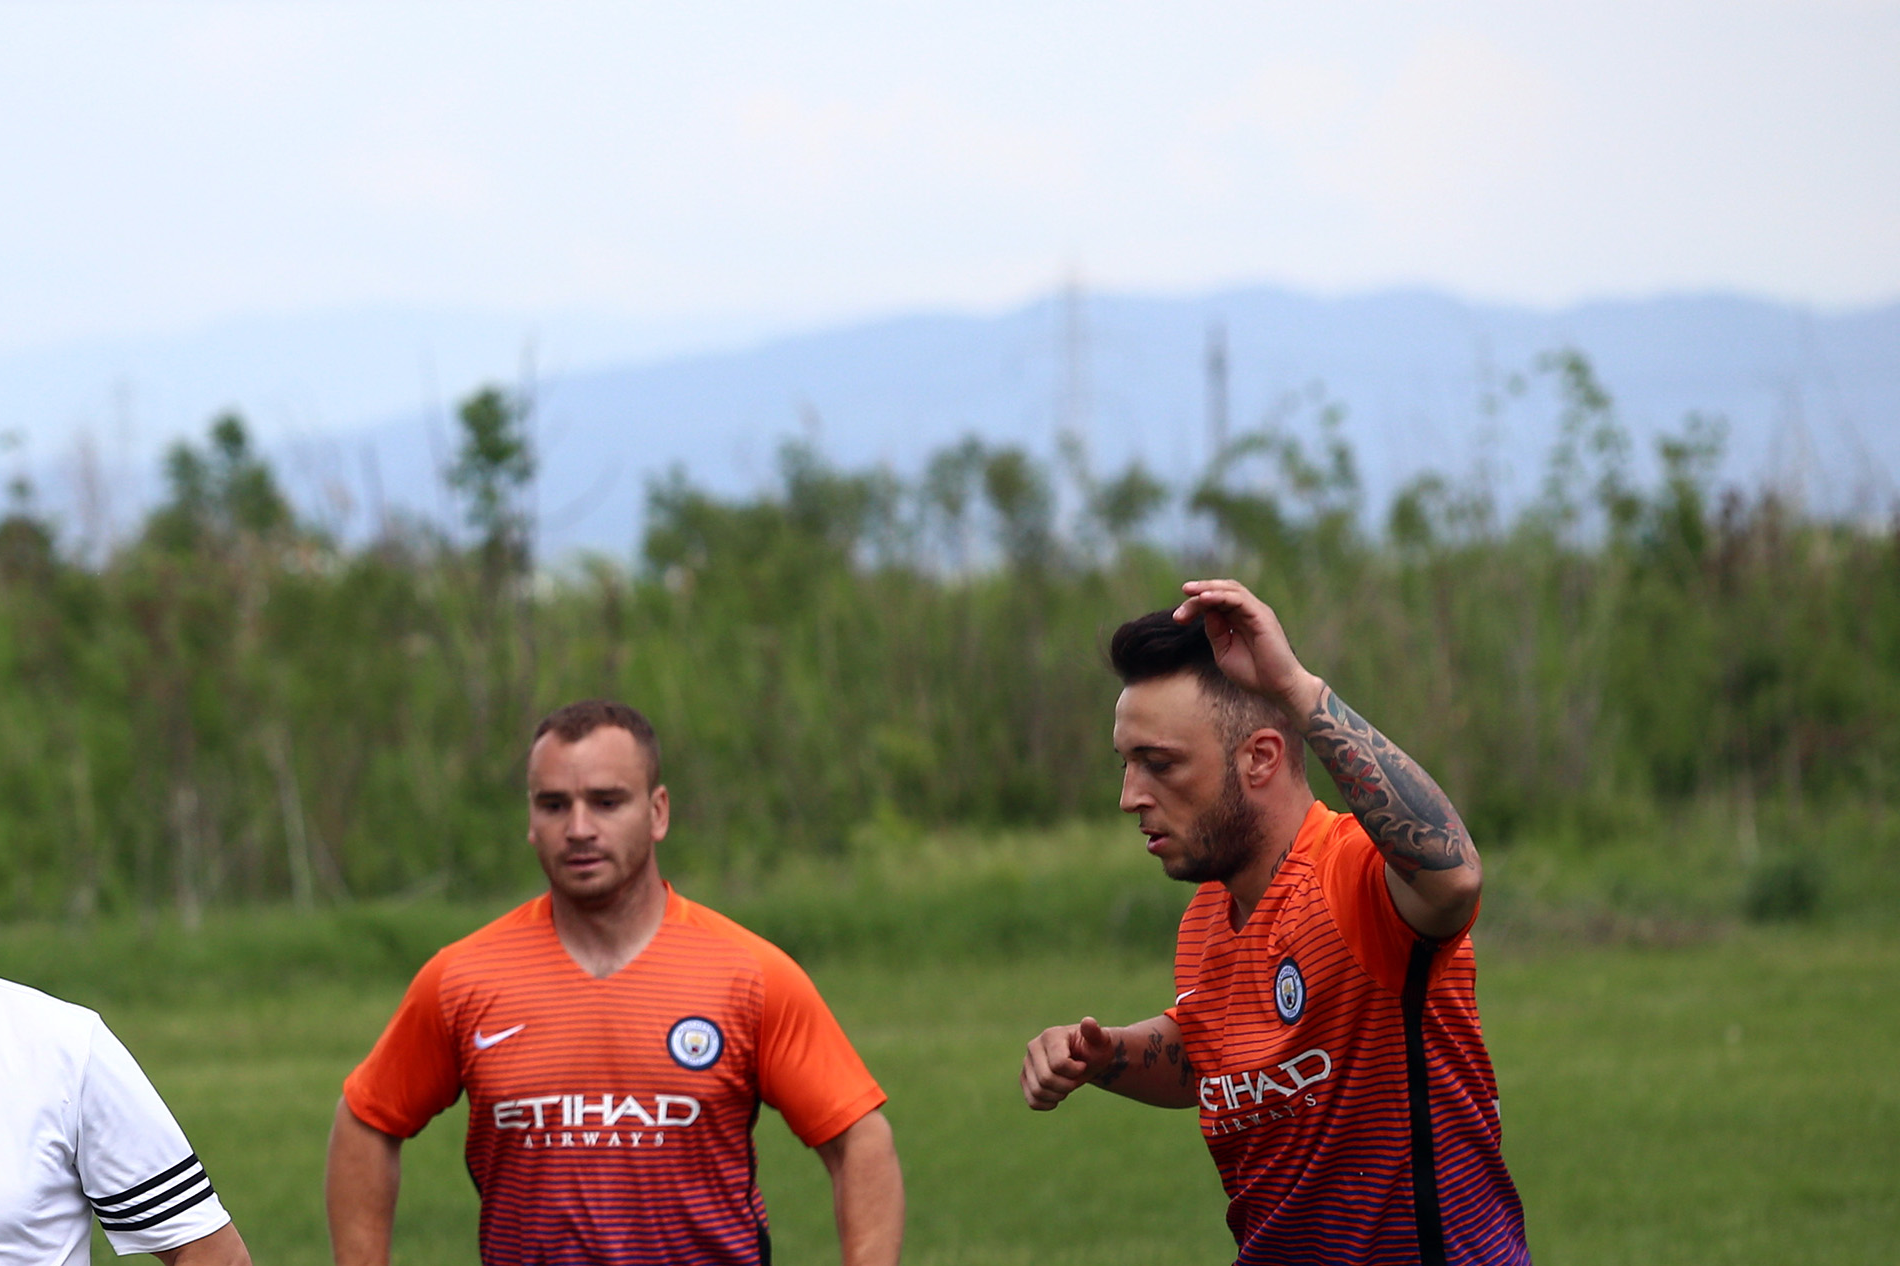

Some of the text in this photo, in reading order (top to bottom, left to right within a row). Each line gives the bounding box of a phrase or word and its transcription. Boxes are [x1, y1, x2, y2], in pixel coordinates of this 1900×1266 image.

[493, 1093, 701, 1129] ETIHAD
[1211, 1093, 1317, 1136] AIRWAYS
[523, 1131, 665, 1149] AIRWAYS
